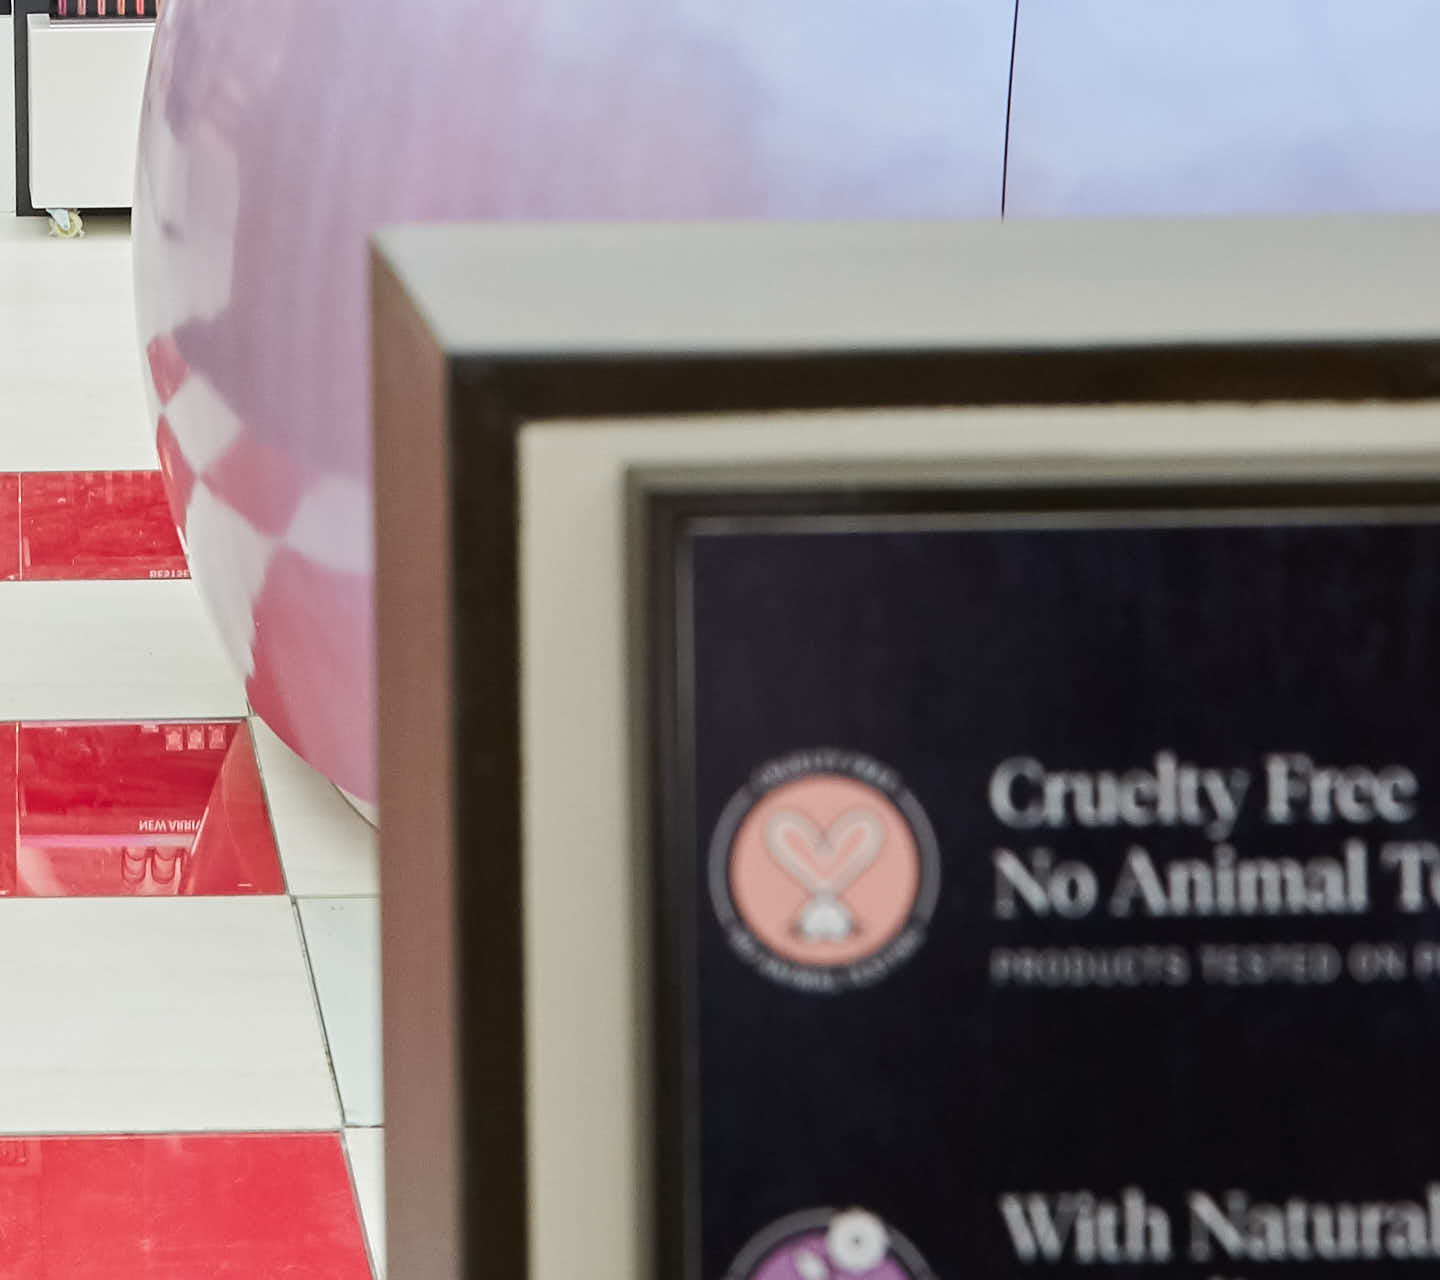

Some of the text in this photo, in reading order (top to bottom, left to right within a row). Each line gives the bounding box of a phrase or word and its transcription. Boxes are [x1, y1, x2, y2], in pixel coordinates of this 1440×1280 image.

[987, 751, 1249, 839] Cruelty
[1264, 753, 1419, 824] Free
[992, 847, 1097, 921] No
[1111, 841, 1369, 918] Animal
[1198, 946, 1341, 984] TESTED
[999, 1185, 1173, 1264] With
